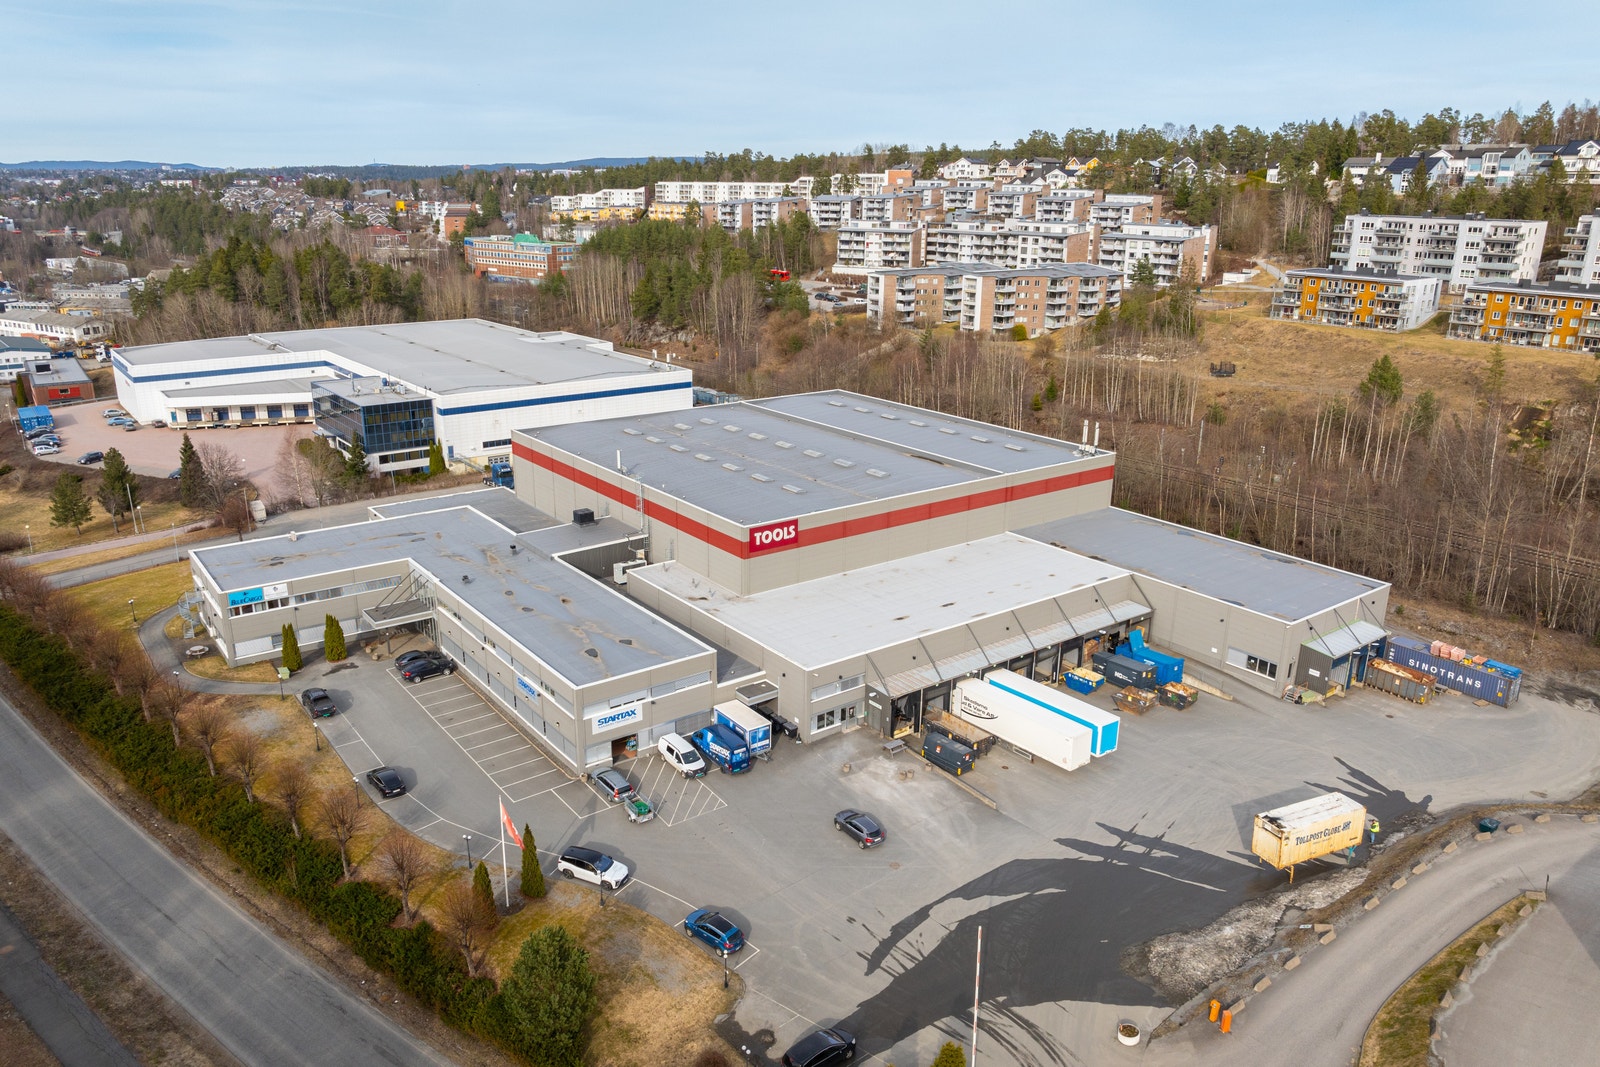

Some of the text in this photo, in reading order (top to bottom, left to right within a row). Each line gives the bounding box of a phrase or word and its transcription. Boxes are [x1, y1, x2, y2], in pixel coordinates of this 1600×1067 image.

[754, 525, 796, 546] TOOLS
[1408, 659, 1482, 688] SINOTRANS
[517, 677, 536, 696] STARTAX
[597, 708, 637, 727] STARTAX
[1295, 830, 1324, 846] TOLLPOST
[1323, 825, 1342, 839] GLOBE
